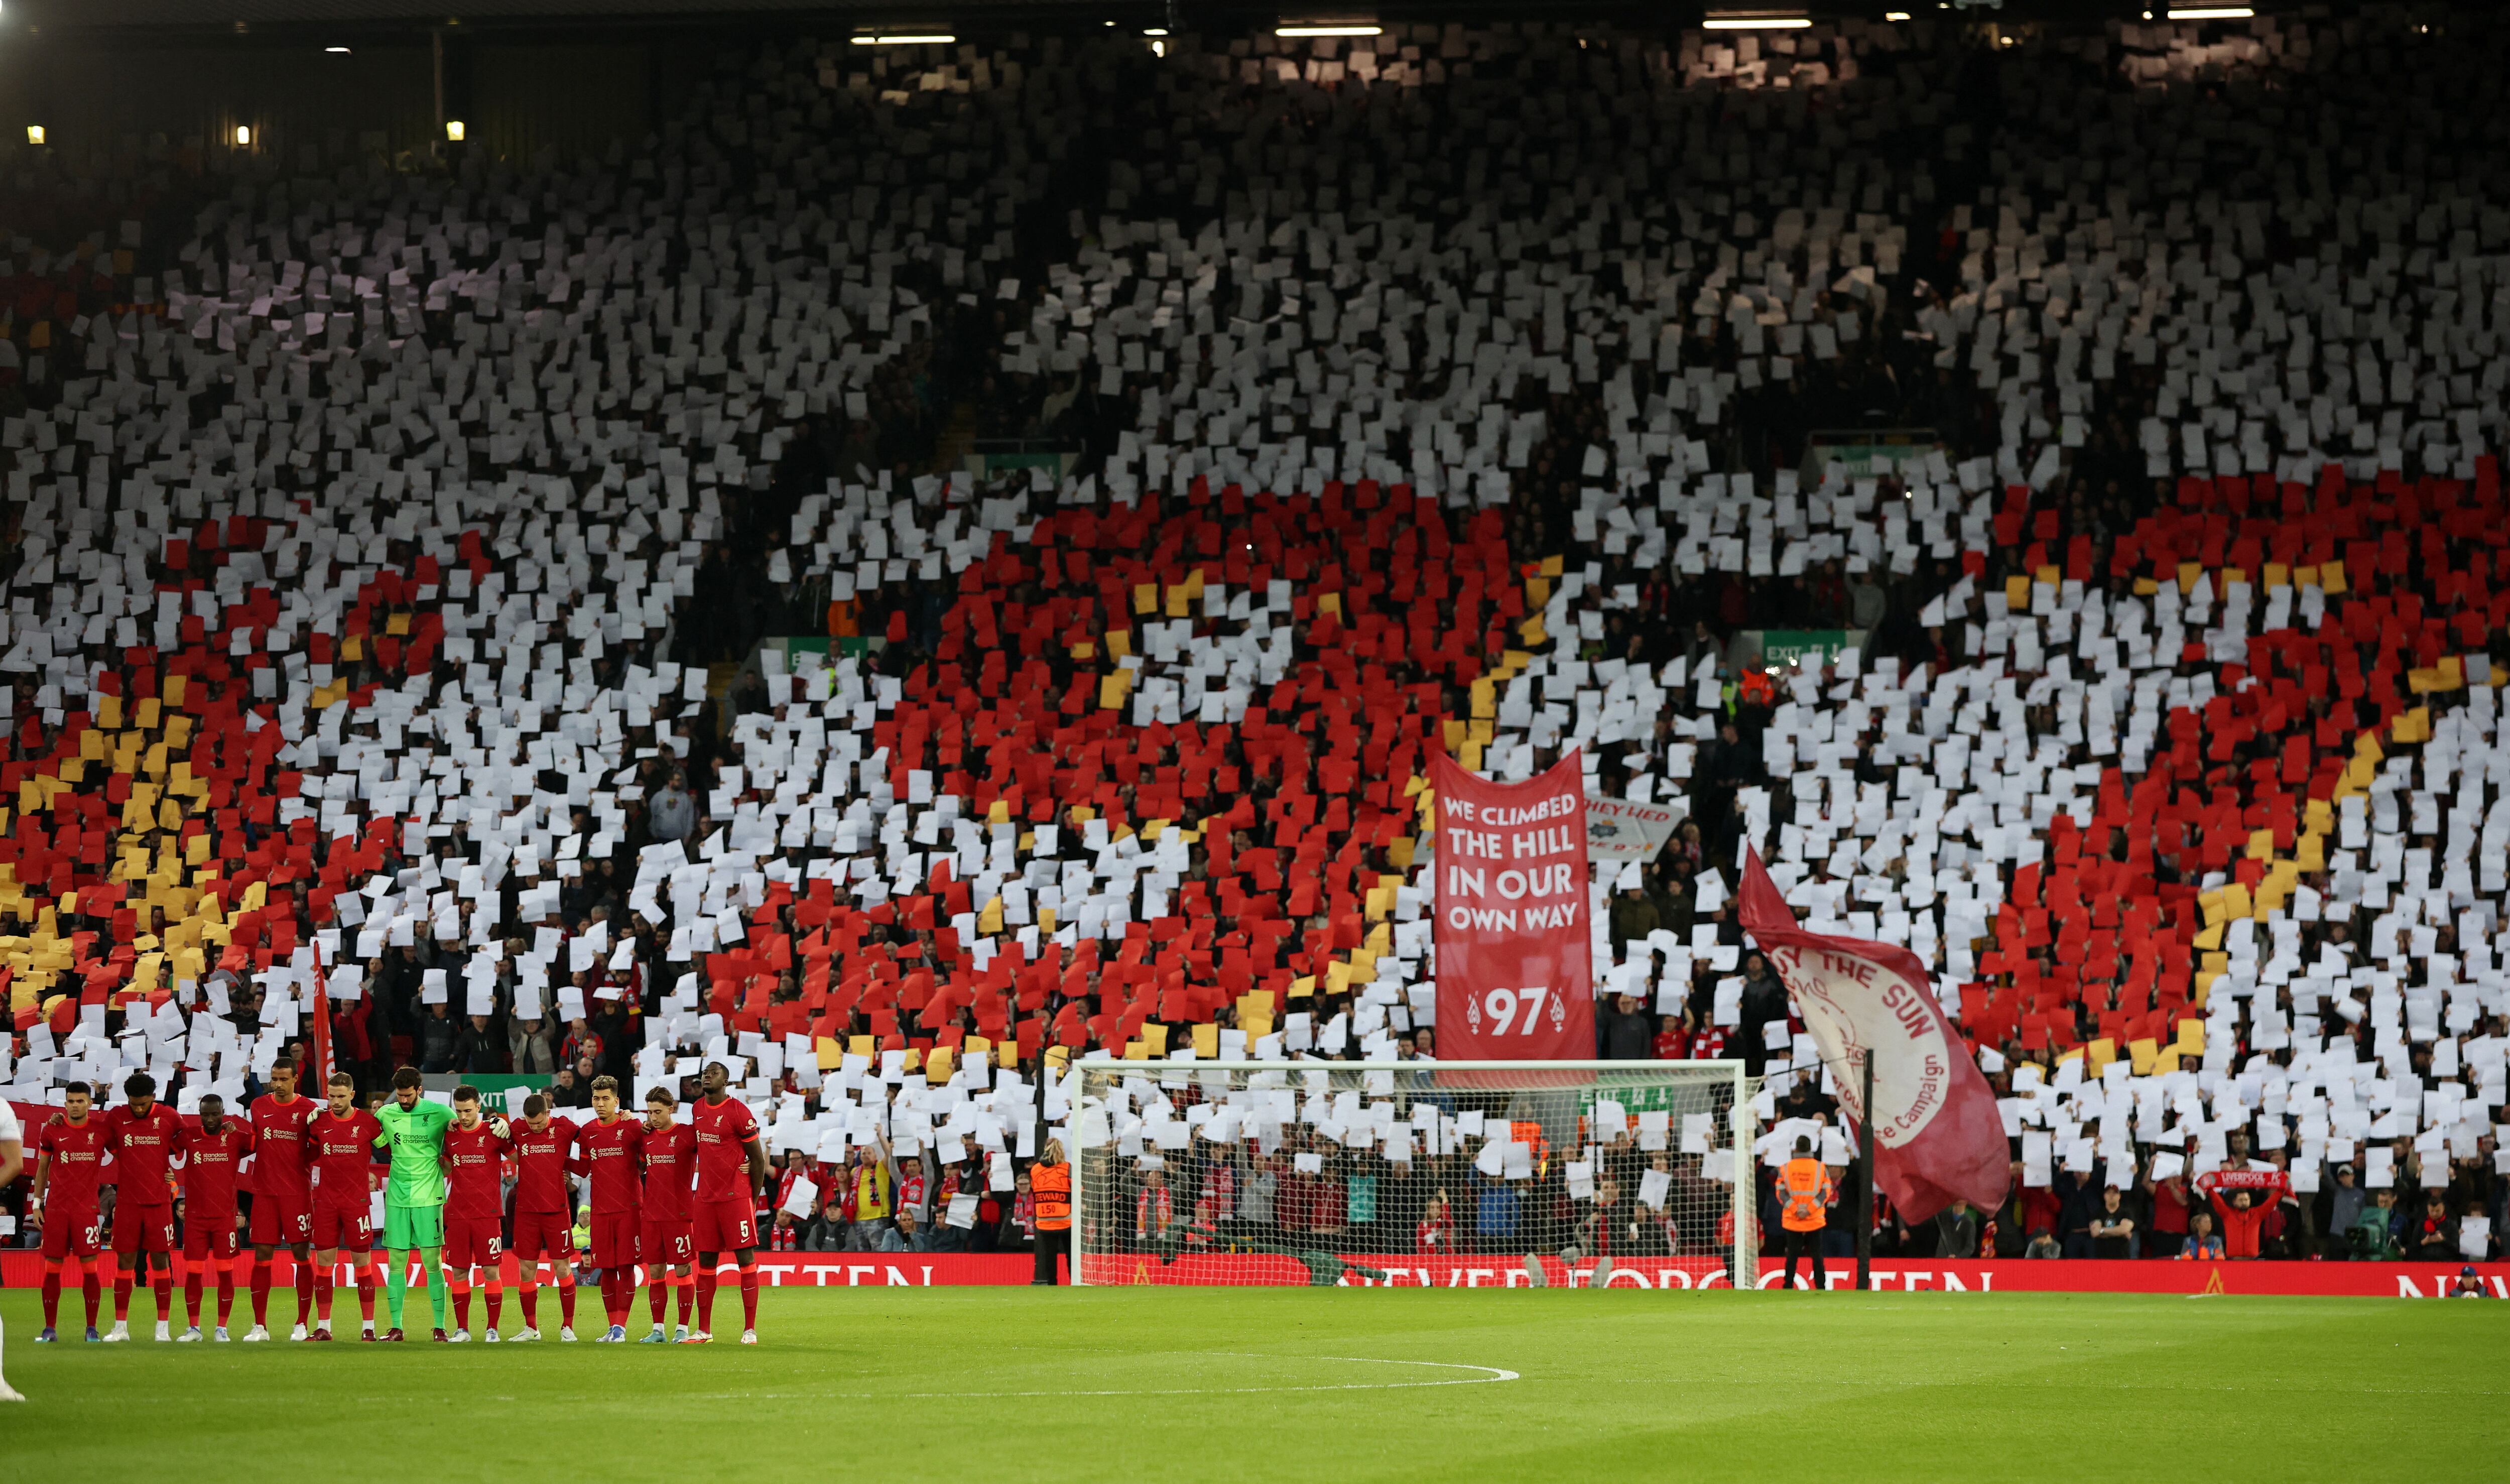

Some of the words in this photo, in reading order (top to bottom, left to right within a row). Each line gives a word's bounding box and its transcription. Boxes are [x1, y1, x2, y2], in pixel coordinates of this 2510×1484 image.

[1767, 646, 1802, 661] EXIT
[1444, 796, 1475, 821] WE
[1481, 793, 1576, 826] CLIMBED
[1626, 805, 1670, 822] LIED
[1447, 827, 1503, 860] THE
[1512, 825, 1575, 859] HILL
[1449, 864, 1485, 899] IN
[1496, 862, 1574, 900] OUR
[1449, 906, 1517, 932] OWN
[1524, 901, 1578, 931] WAY
[1821, 953, 1877, 990] THE
[1881, 983, 1935, 1040] SUN
[1484, 985, 1548, 1037] 97
[478, 1092, 504, 1107] XIT
[1895, 1054, 1945, 1130] Campaign
[2221, 1172, 2266, 1181] LIVERPOOL
[2271, 1172, 2282, 1180] FC
[1035, 1192, 1066, 1202] TEWARD
[1041, 1205, 1056, 1214] 150
[297, 1213, 312, 1231] 32
[357, 1215, 370, 1233] 14
[434, 1217, 439, 1233] 1
[740, 1220, 749, 1238] 5
[85, 1226, 99, 1244] 23
[164, 1223, 174, 1242] 12
[229, 1231, 235, 1249] 8
[561, 1229, 569, 1247] 7
[488, 1236, 501, 1255] 20
[635, 1235, 640, 1252] 9
[675, 1234, 691, 1254] 21
